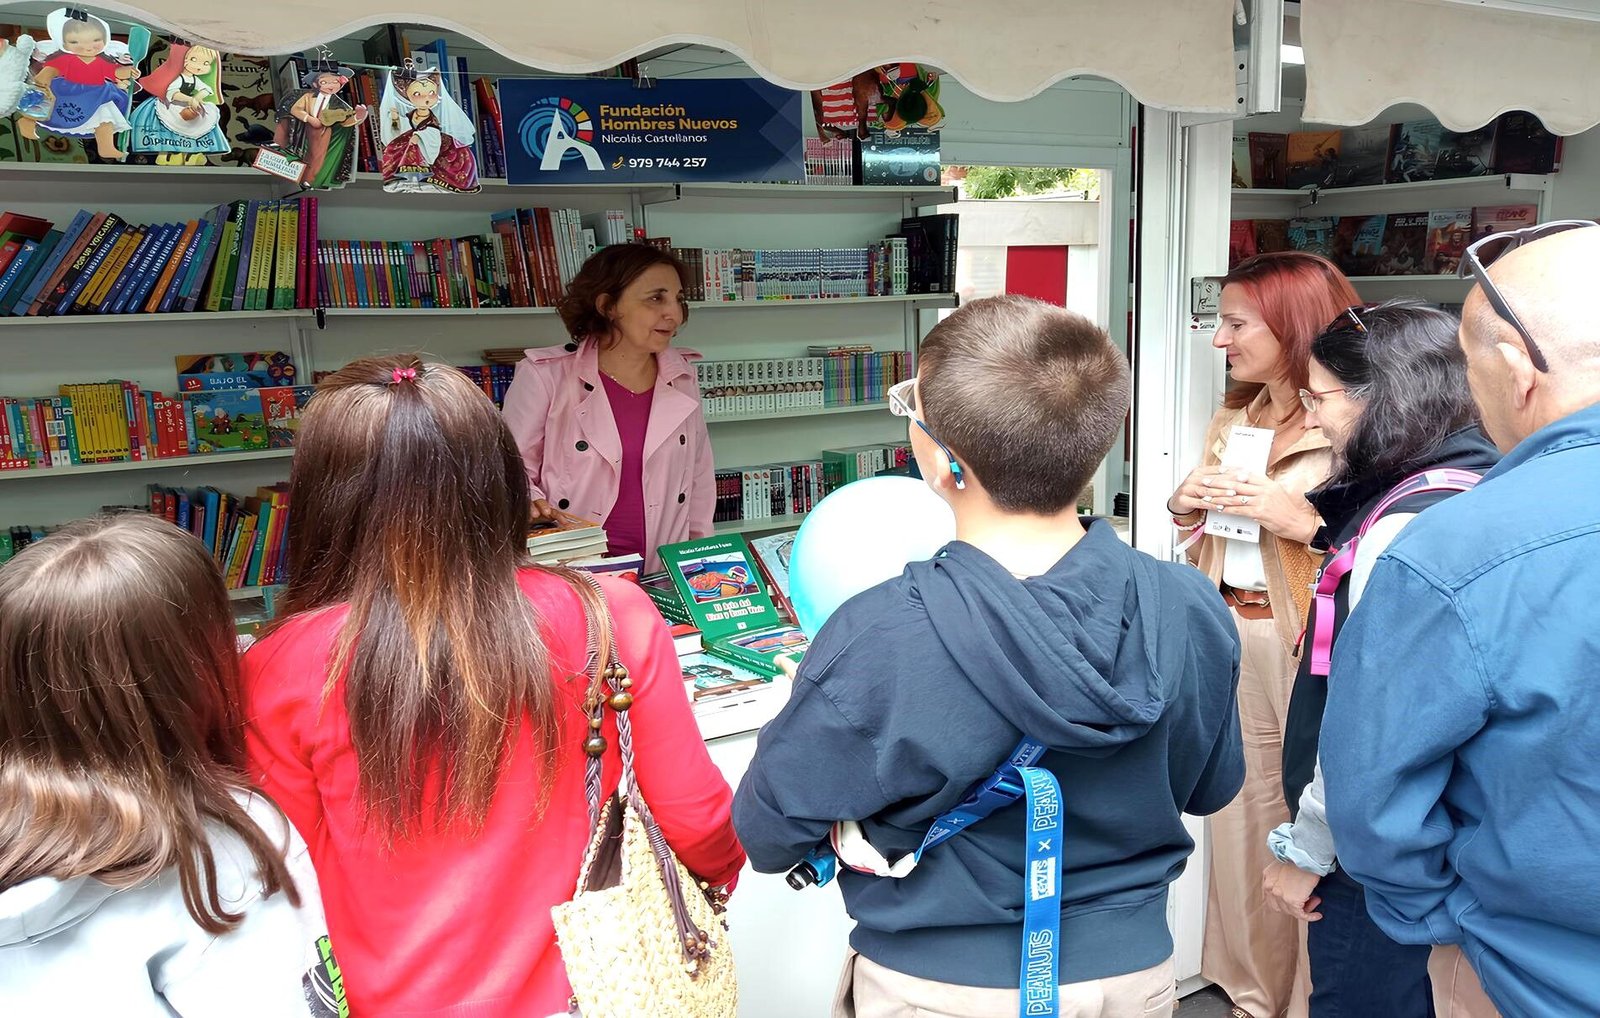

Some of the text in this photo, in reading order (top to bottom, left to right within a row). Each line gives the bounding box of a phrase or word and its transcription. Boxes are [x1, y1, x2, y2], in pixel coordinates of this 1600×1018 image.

[600, 104, 686, 117] Fundación
[601, 118, 738, 131] Hombres Nuevos
[602, 133, 708, 144] Nicolás Castellanos
[629, 157, 707, 168] 979 744 257
[1026, 929, 1054, 1016] PEANUTS
